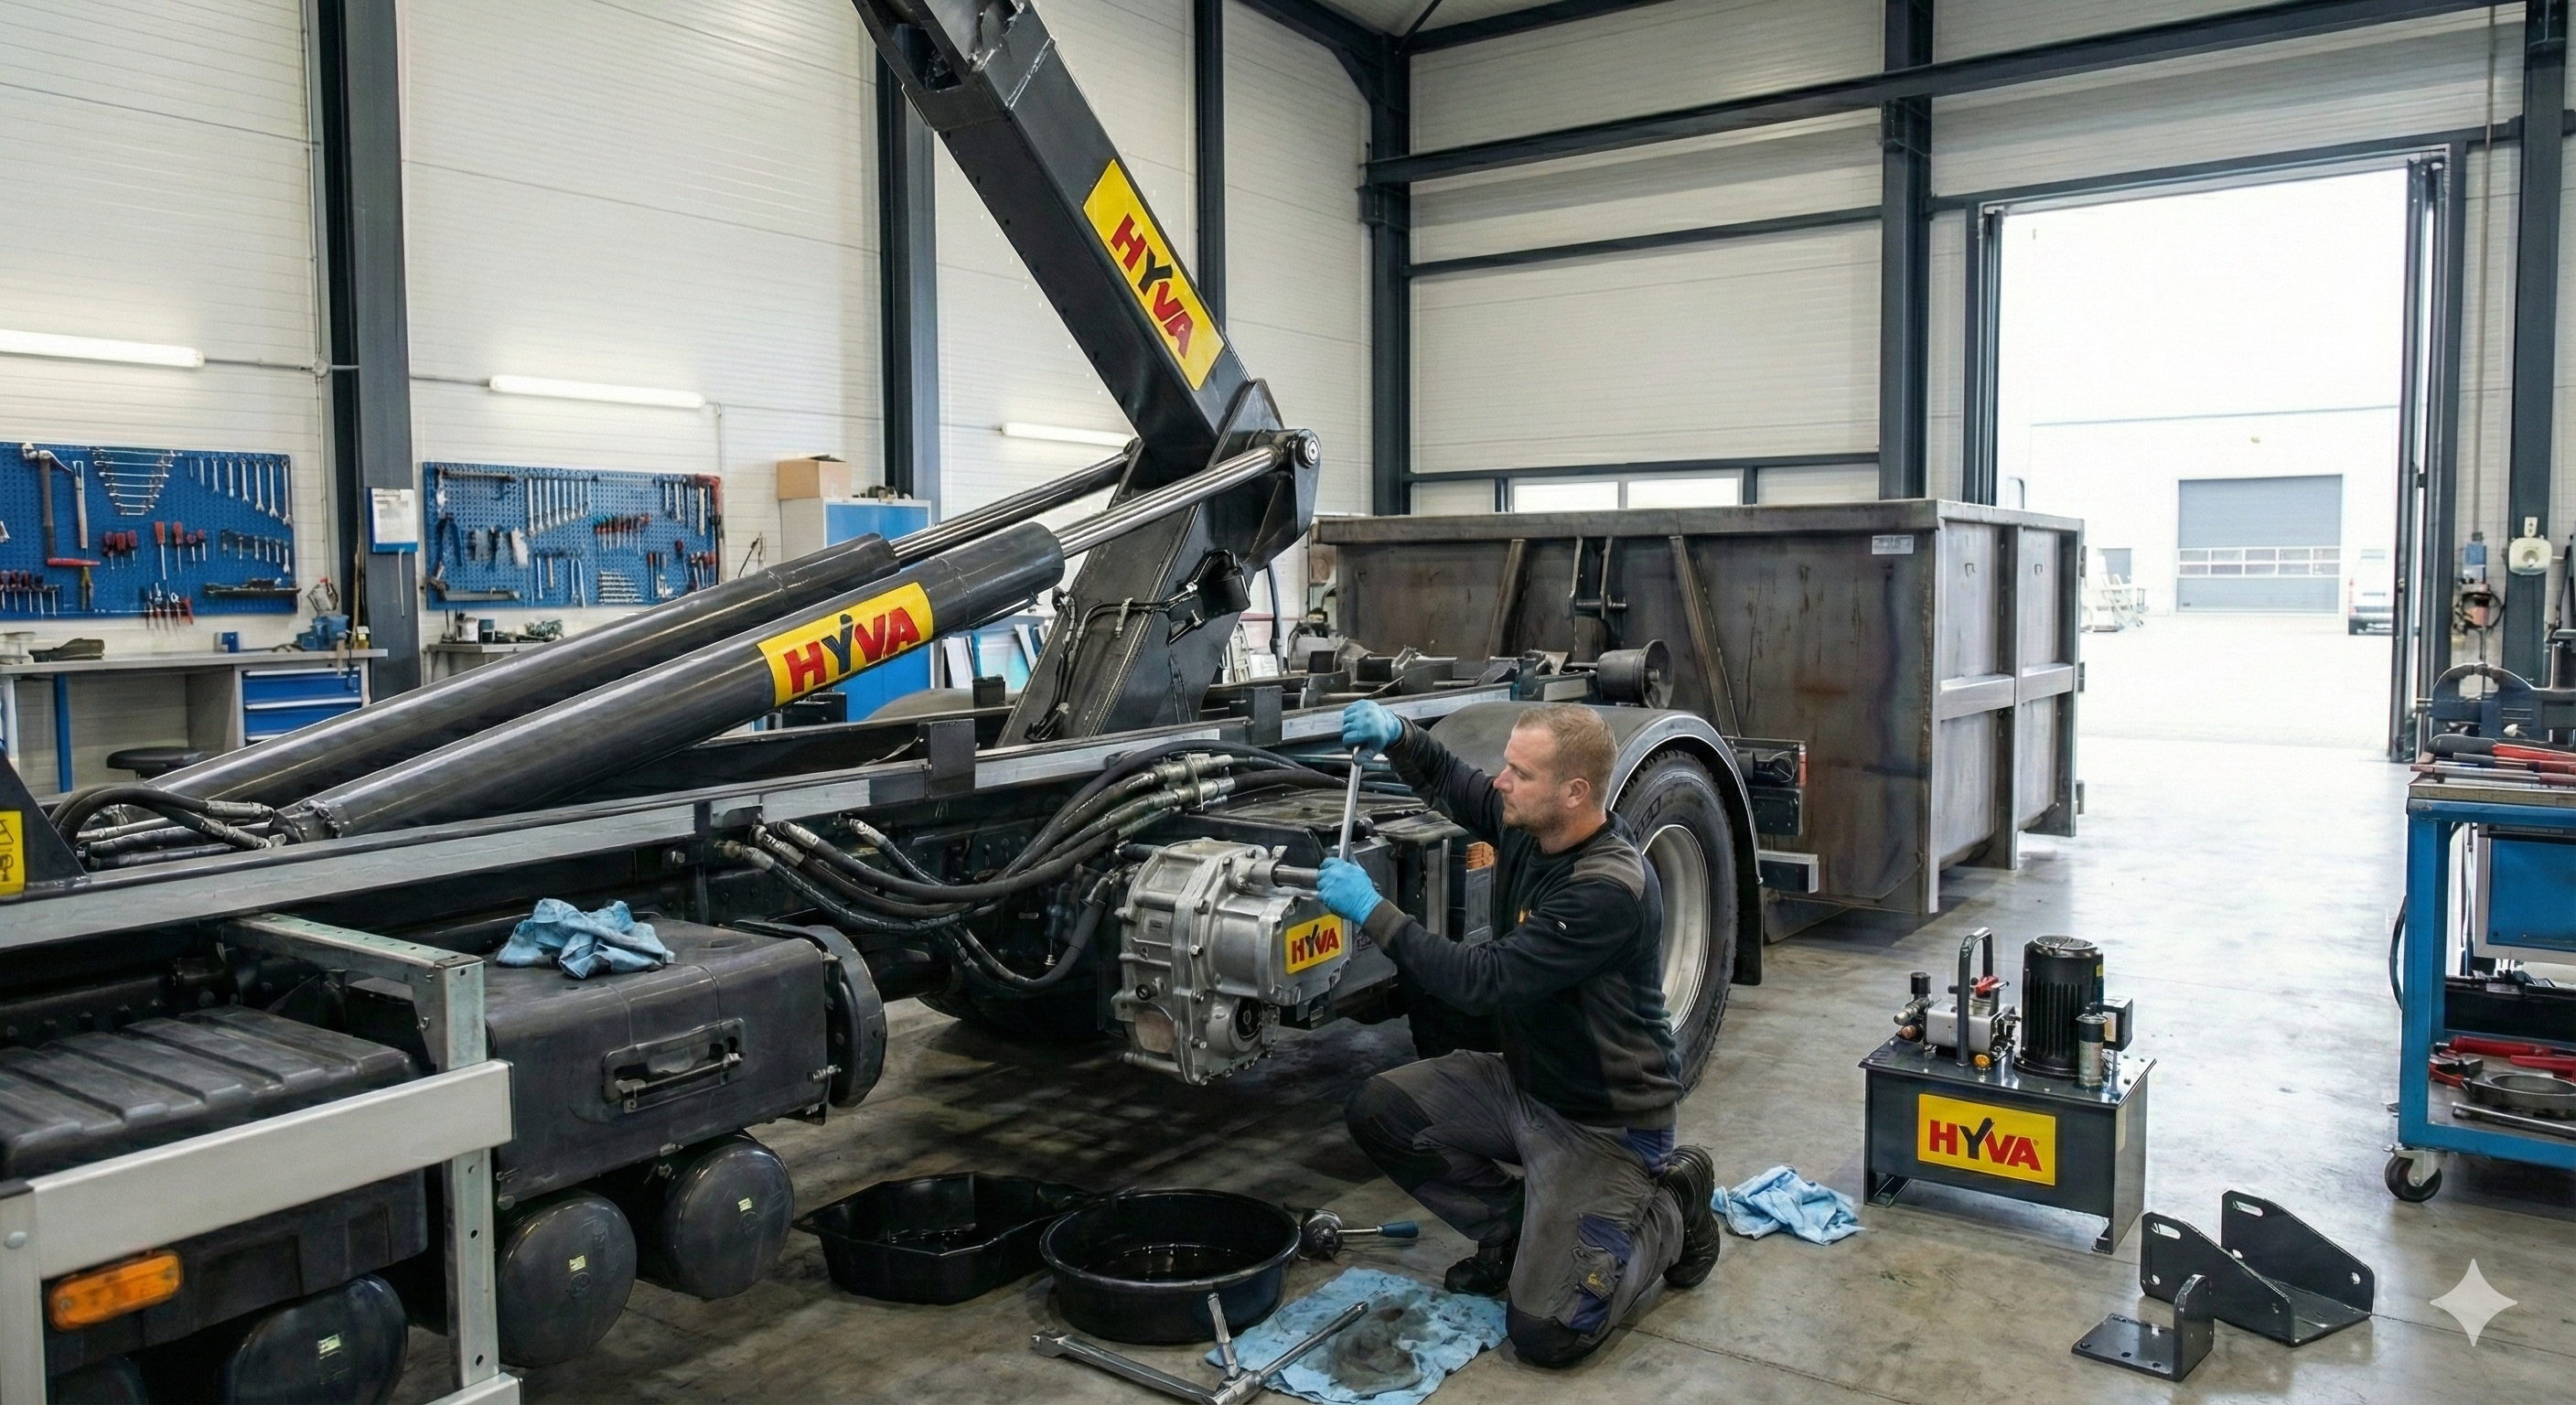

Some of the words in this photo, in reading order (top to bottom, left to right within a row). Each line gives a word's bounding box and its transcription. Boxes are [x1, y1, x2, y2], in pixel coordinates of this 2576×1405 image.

[1110, 211, 1194, 359] HYVA
[783, 606, 921, 695] HYVA
[1291, 924, 1340, 965] HYVA
[1929, 1117, 2043, 1173] HYVA
